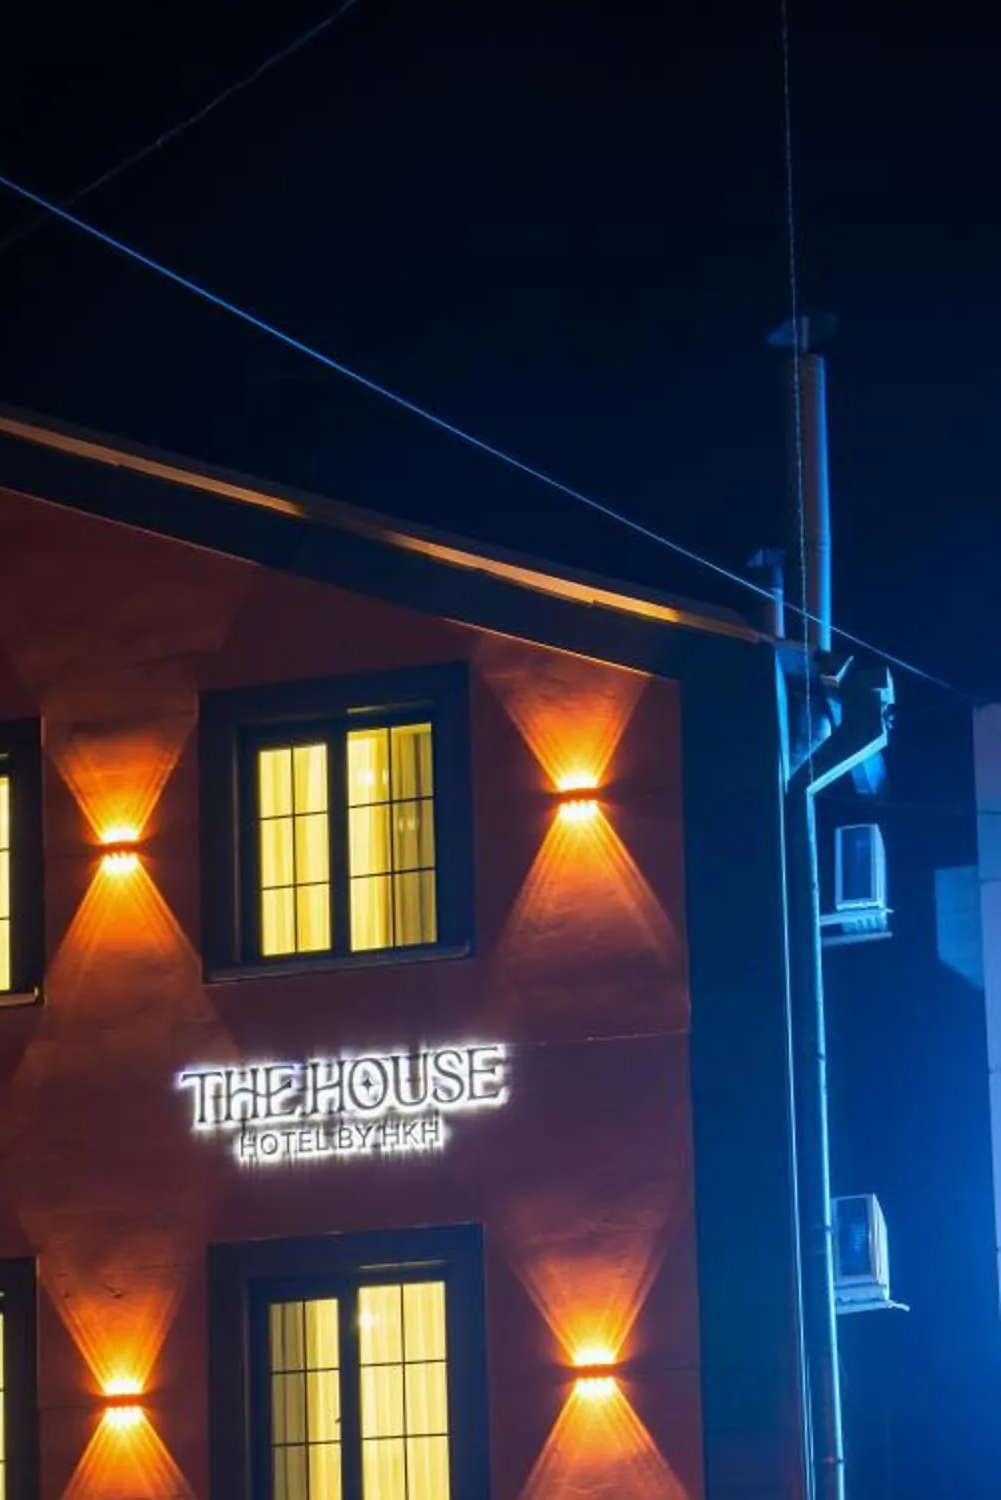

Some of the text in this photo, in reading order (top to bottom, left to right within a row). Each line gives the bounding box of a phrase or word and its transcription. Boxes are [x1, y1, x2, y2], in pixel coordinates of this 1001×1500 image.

[181, 1045, 501, 1124] THE HOUSE
[239, 1120, 440, 1158] HOTEL BY HKH
